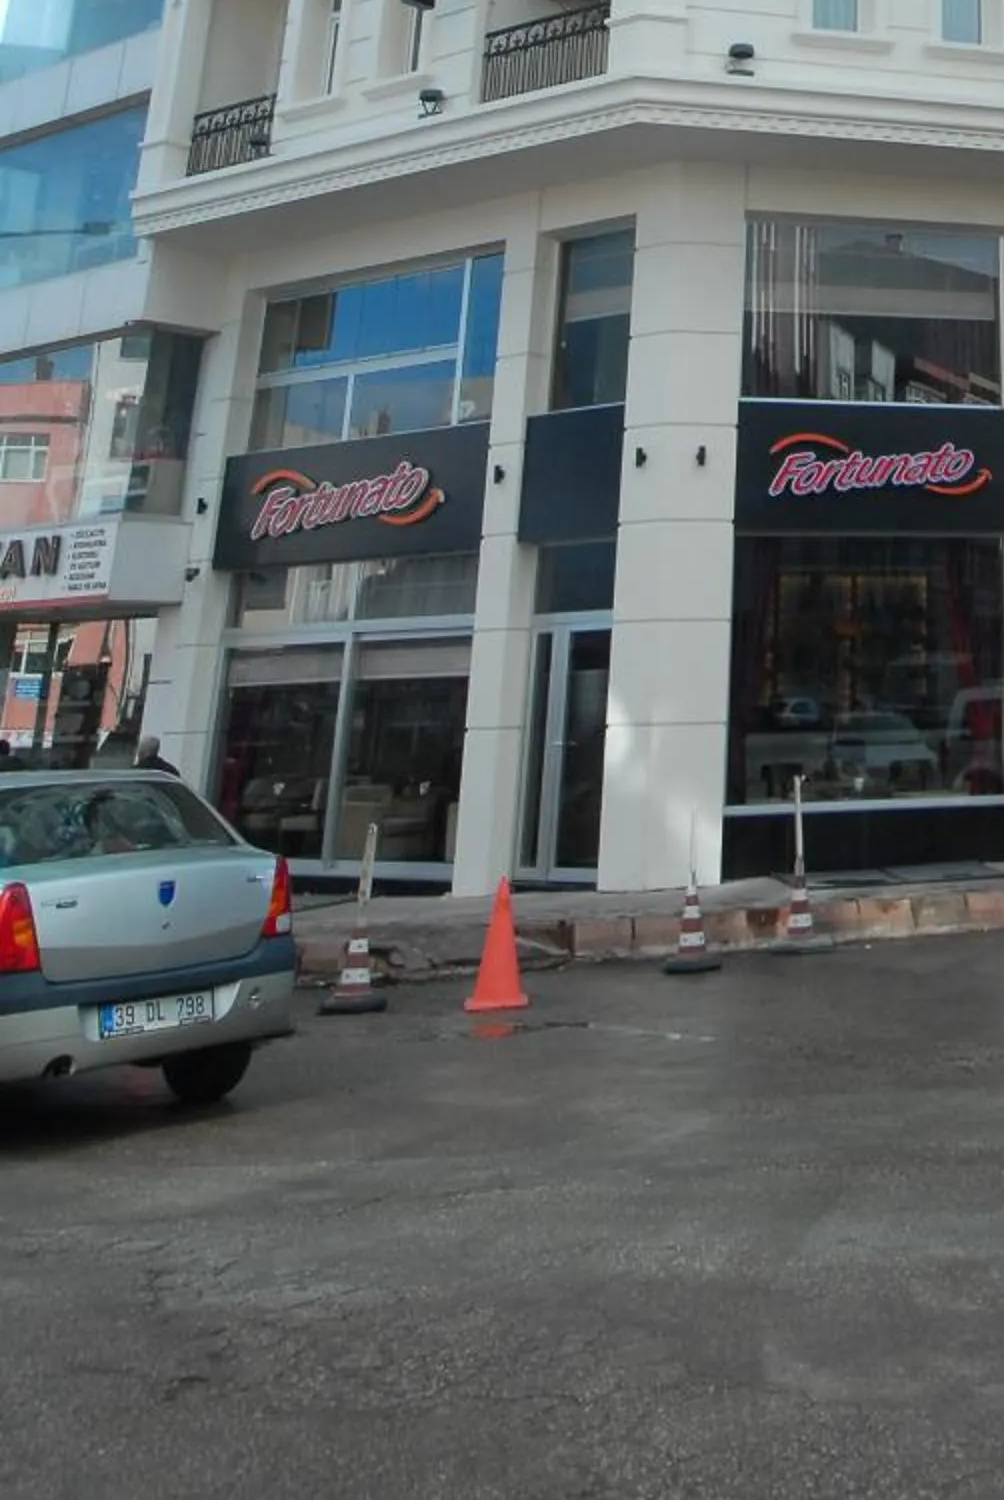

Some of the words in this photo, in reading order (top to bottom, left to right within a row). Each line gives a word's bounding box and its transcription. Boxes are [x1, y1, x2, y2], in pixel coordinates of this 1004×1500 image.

[768, 442, 975, 497] Fortunato
[250, 460, 429, 541] Fortunato
[0, 534, 62, 581] AN
[114, 1004, 135, 1027] 39
[146, 1001, 165, 1023] DL
